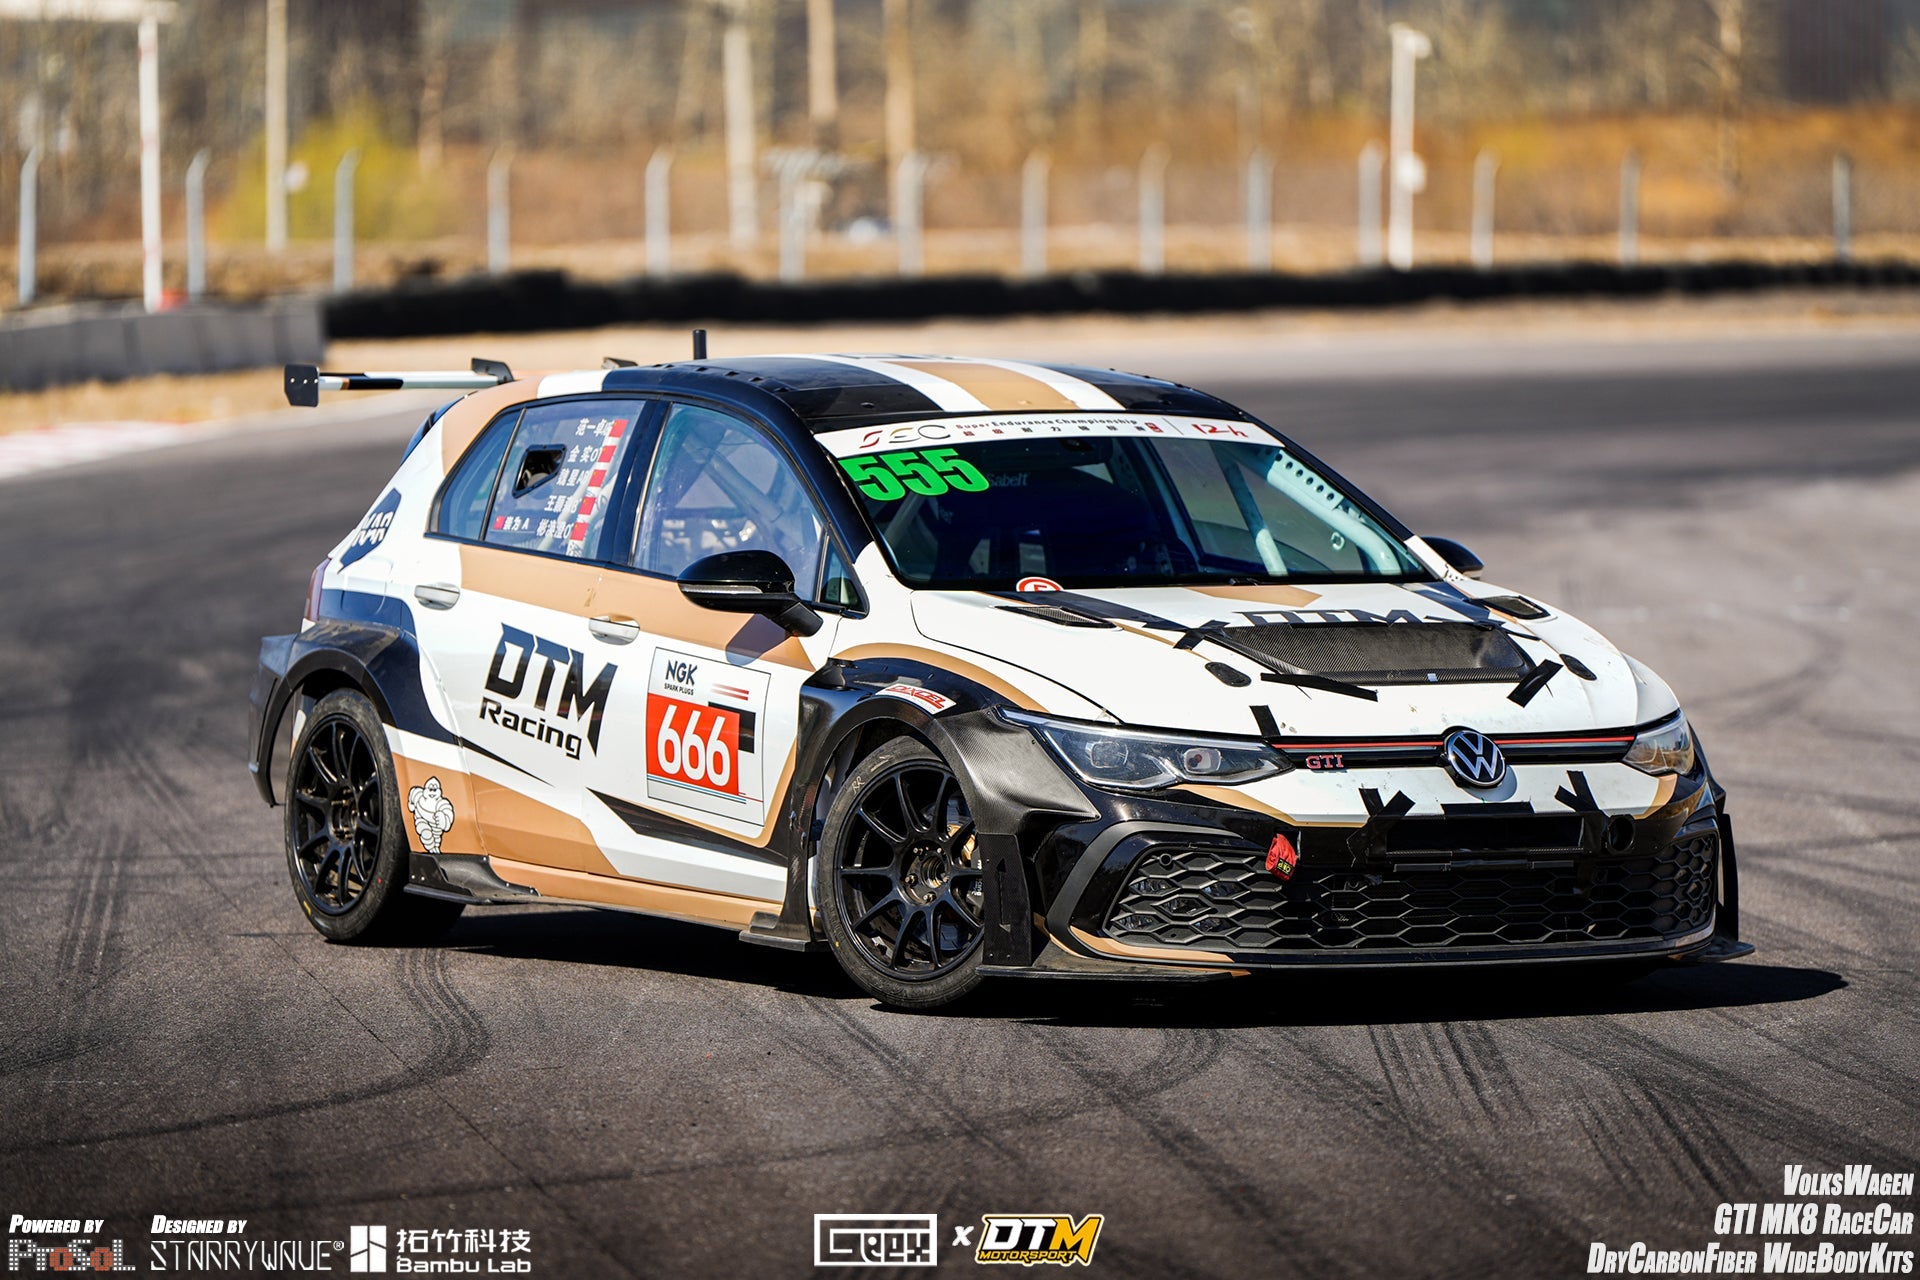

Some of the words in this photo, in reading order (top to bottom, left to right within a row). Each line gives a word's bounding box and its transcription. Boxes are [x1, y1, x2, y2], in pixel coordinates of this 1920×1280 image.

[838, 448, 990, 501] 555
[485, 622, 619, 757] DTM
[663, 682, 679, 692] SPARK
[678, 686, 694, 696] PLUGS
[665, 659, 698, 687] NGK
[480, 696, 583, 760] Racing
[657, 704, 731, 787] 666
[1305, 754, 1345, 770] GTI
